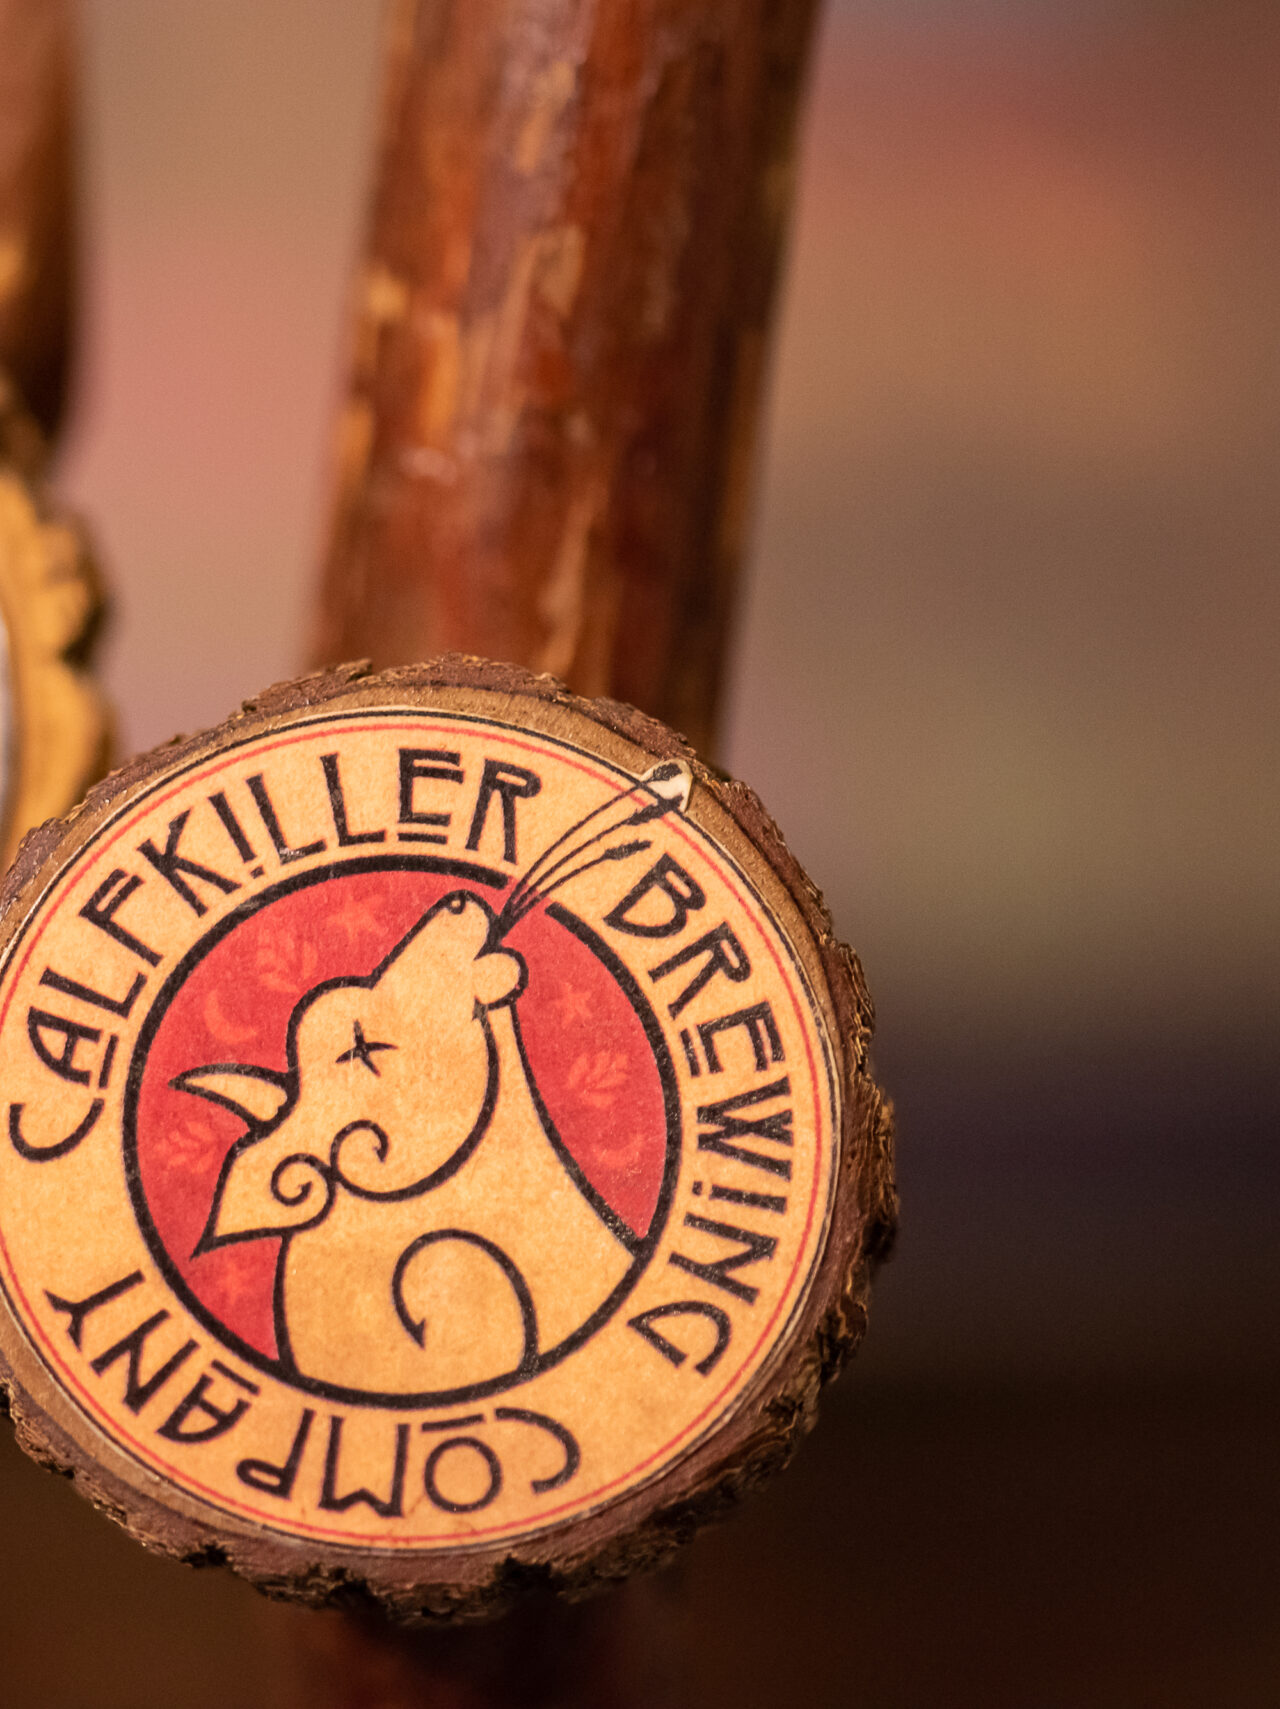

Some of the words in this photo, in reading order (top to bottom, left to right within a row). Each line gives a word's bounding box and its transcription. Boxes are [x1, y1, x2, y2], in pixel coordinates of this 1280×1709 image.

[8, 748, 541, 1164] CALFKILLER
[602, 861, 794, 1375] BREWING
[45, 1271, 580, 1517] COMPANY
